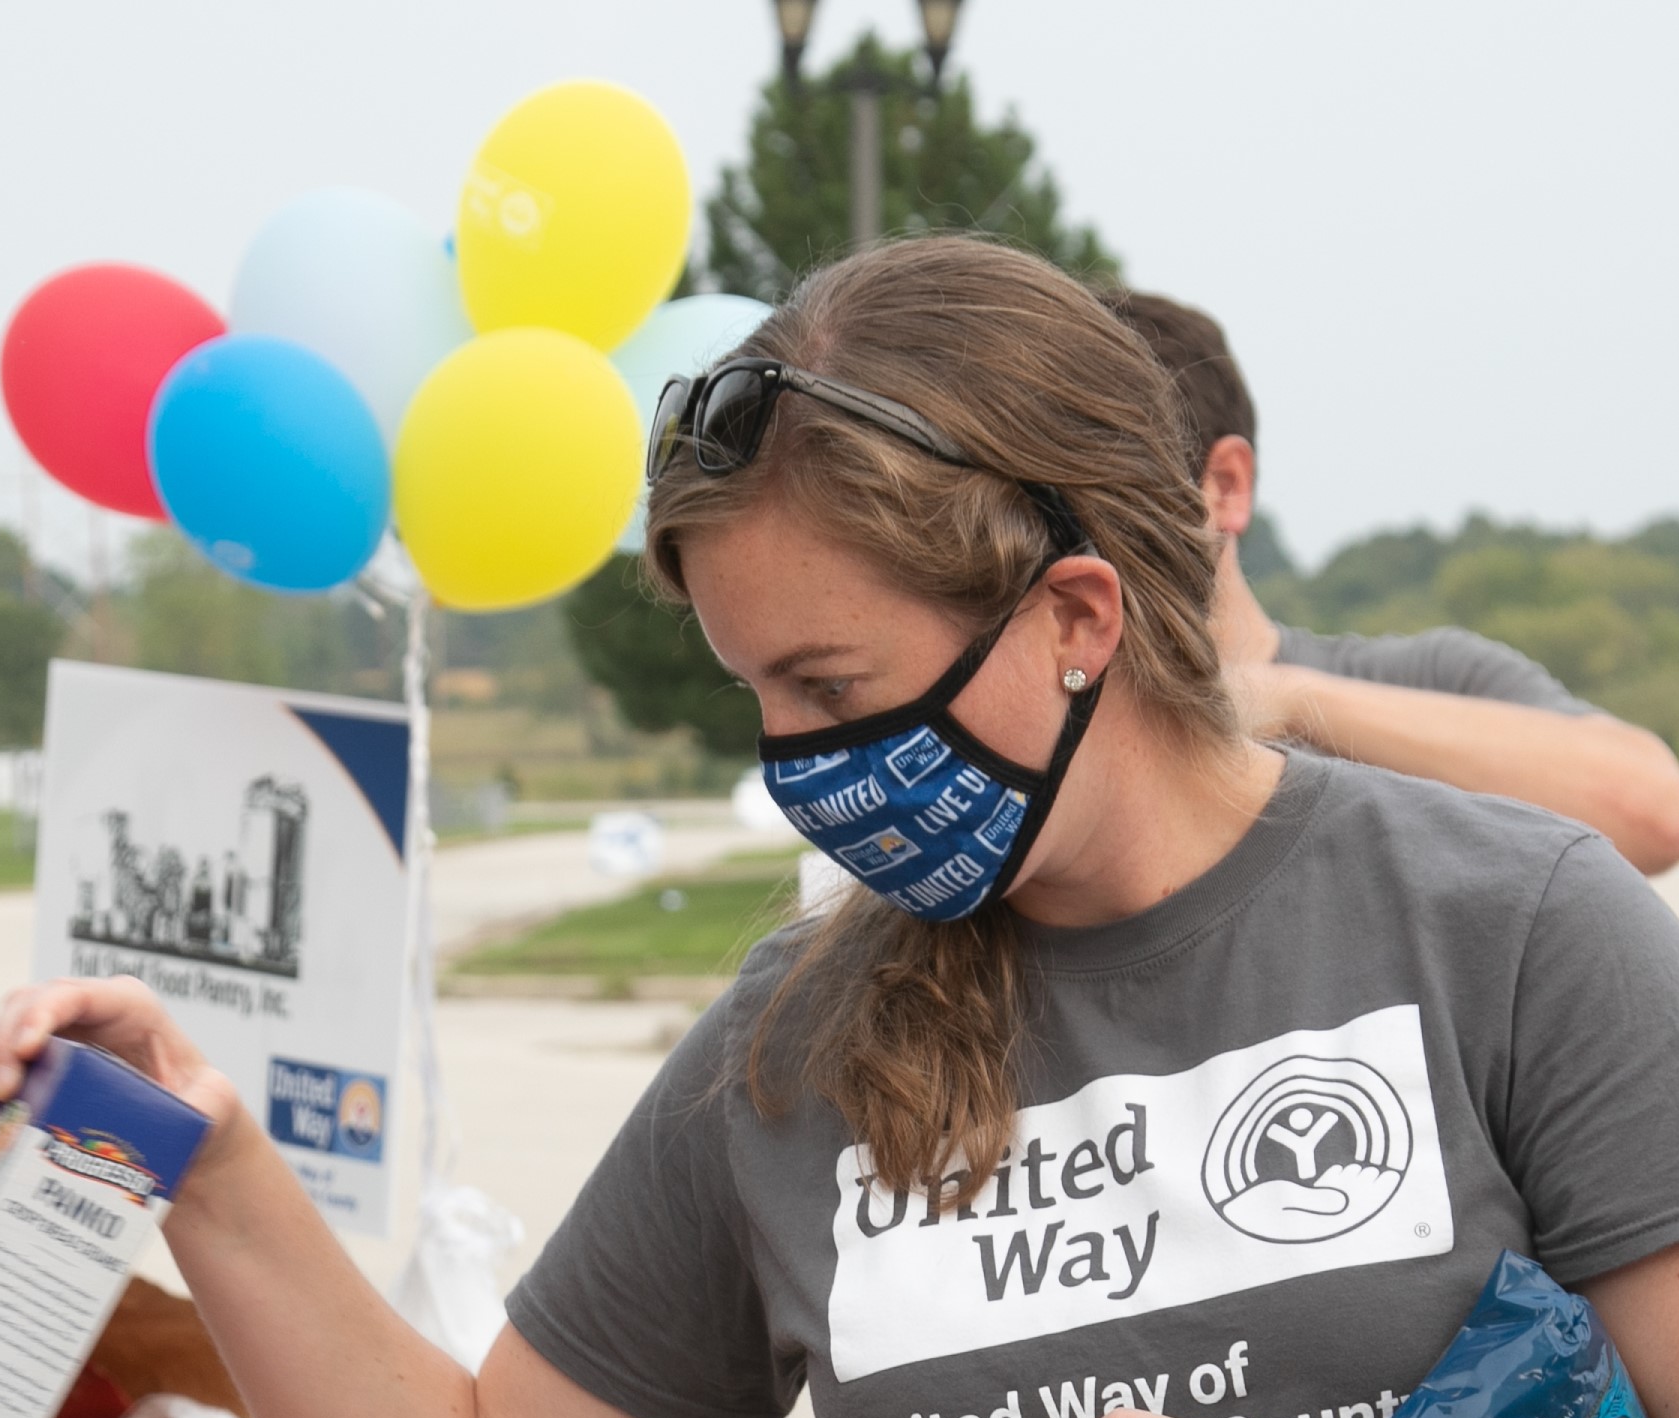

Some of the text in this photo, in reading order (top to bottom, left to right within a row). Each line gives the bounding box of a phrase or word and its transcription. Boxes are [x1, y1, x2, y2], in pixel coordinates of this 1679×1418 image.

[895, 735, 935, 771] United
[913, 748, 942, 768] Way
[811, 773, 888, 830] UNITED
[914, 786, 972, 835] LIVE
[982, 801, 1018, 841] United
[907, 852, 984, 909] UNITED
[271, 1061, 335, 1103] United
[292, 1101, 333, 1150] Way
[854, 1105, 1154, 1240] United
[972, 1210, 1160, 1301] Way
[1188, 1340, 1250, 1398] of
